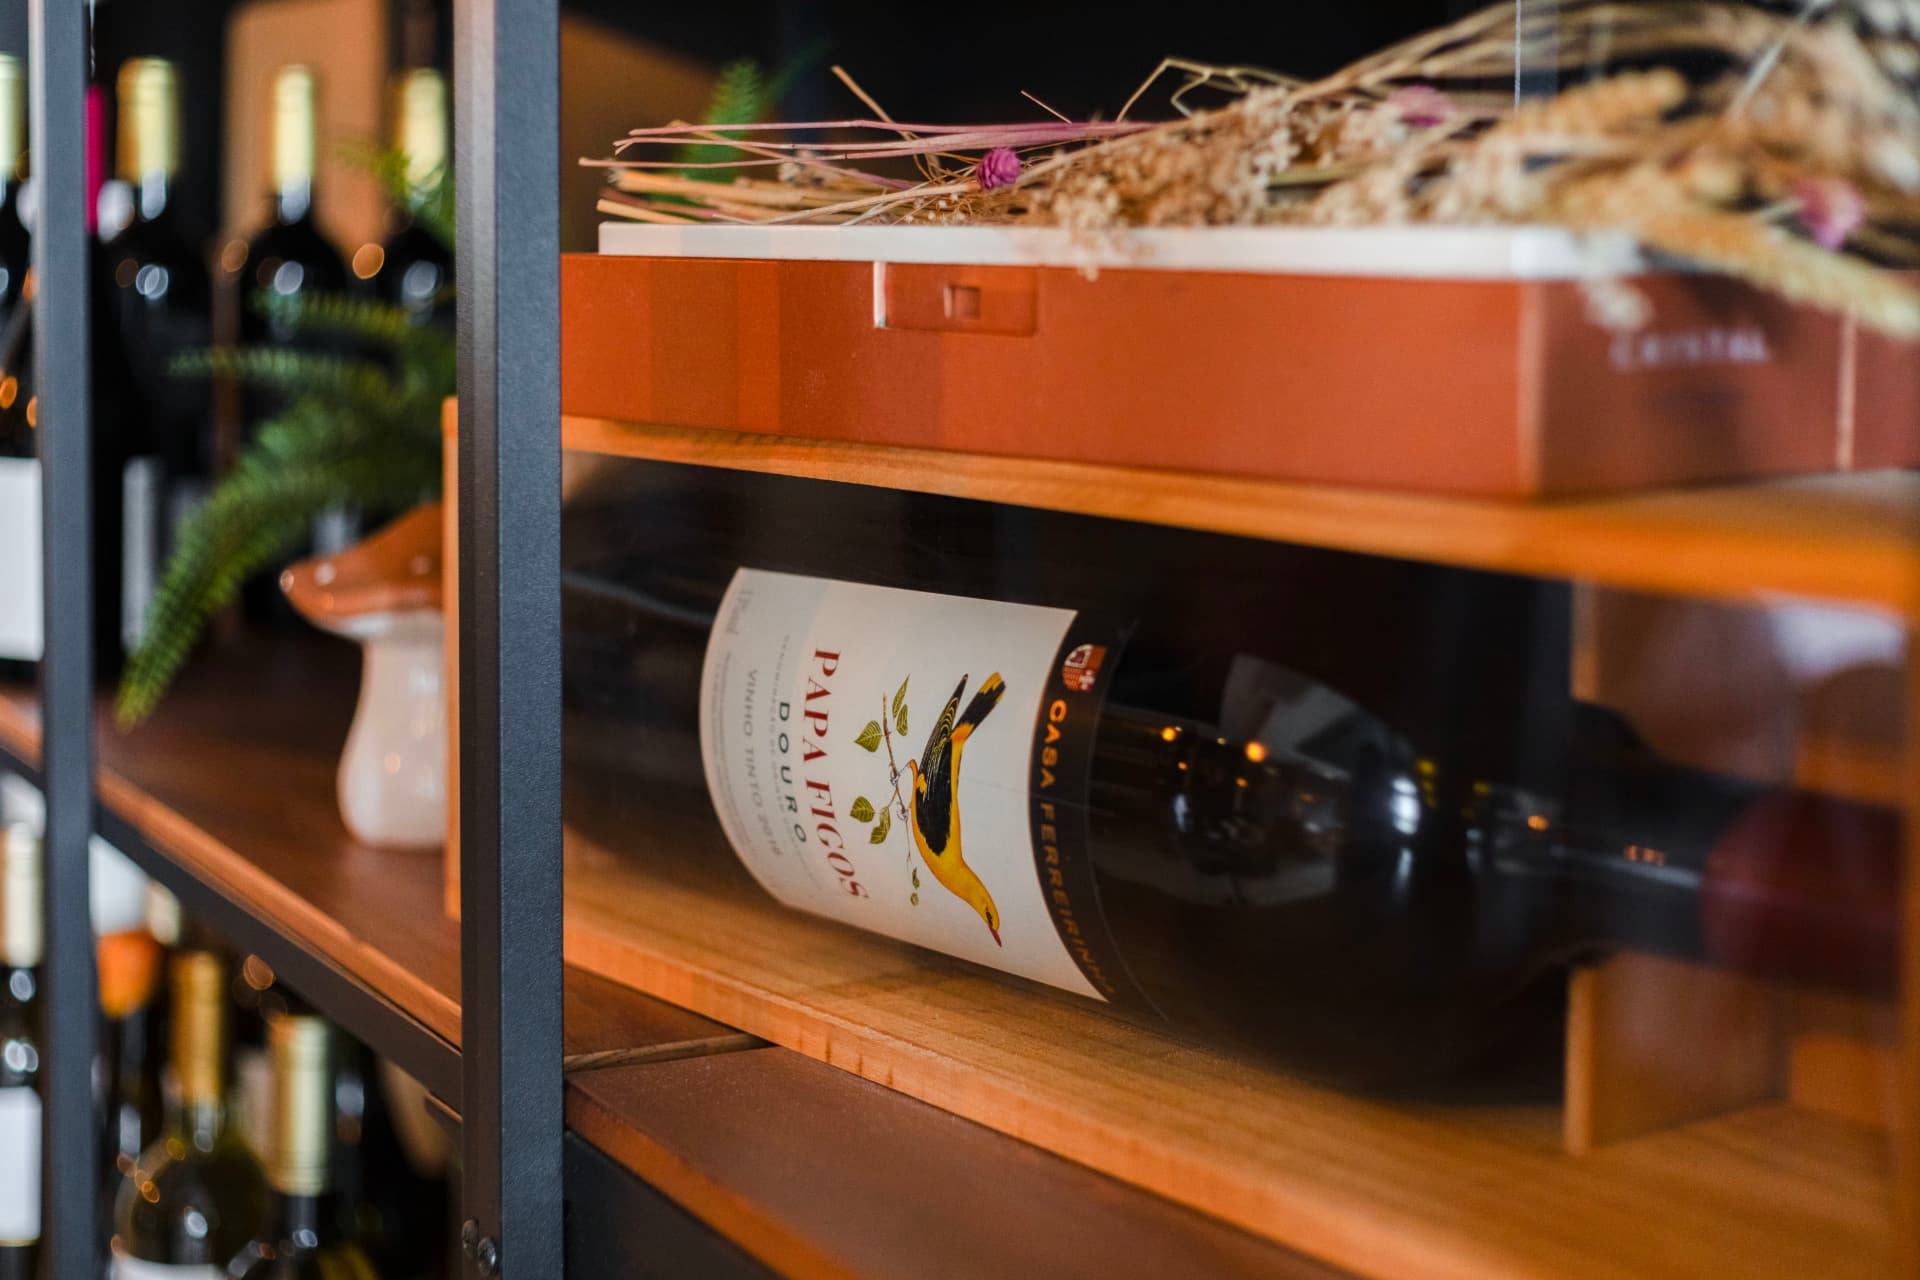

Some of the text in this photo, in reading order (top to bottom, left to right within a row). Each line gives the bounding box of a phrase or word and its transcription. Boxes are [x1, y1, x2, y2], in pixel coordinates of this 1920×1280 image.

[743, 668, 758, 737] VINHO
[802, 647, 842, 763] PAPA
[1040, 699, 1068, 788] CASA
[744, 743, 763, 808] TINTO
[778, 701, 807, 843] DOURO
[804, 779, 870, 900] FIGOS
